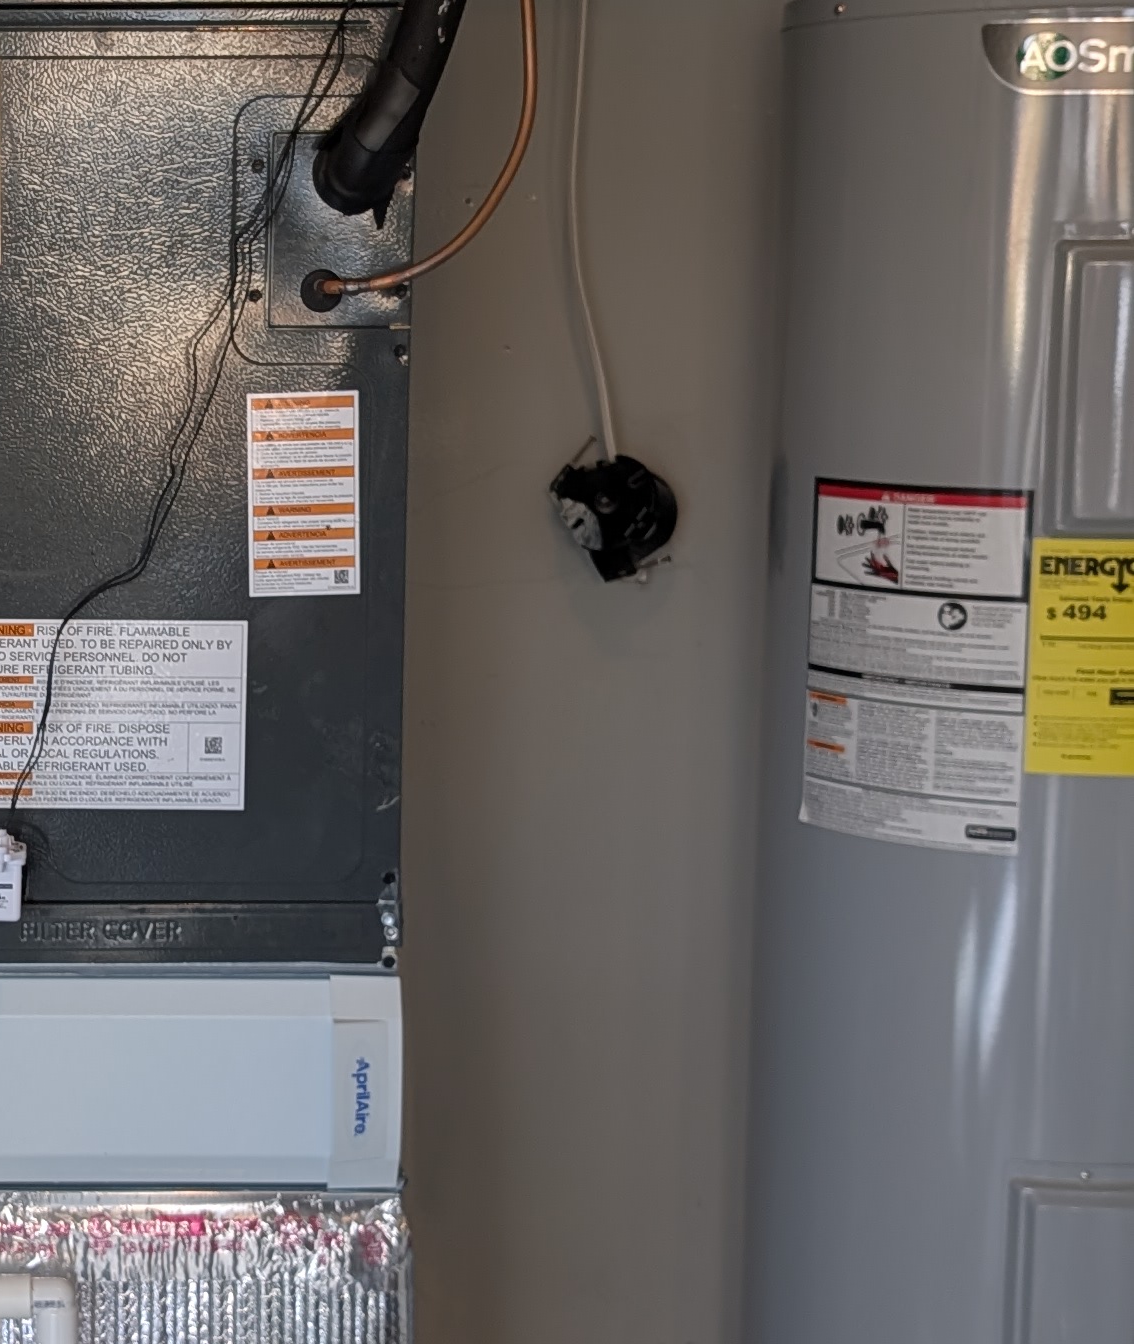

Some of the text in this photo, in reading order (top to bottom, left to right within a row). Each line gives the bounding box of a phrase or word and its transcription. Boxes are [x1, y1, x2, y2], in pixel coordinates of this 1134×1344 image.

[1063, 604, 1107, 621] 494
[68, 626, 84, 636] OF
[86, 626, 116, 636] FIRE.
[119, 627, 190, 637] FLAMMABLE
[81, 639, 96, 650] TO
[100, 639, 116, 650] BE
[119, 640, 180, 650] REPAIRED
[182, 640, 214, 650] ONLY
[217, 640, 233, 650] BY
[64, 652, 139, 662] PERSONNEL.
[142, 652, 159, 663] DO
[162, 653, 187, 663] NOT
[110, 665, 156, 676] TUBING.
[68, 724, 84, 734] OF
[86, 724, 116, 734] FIRE.
[118, 724, 170, 734] DISPOSE
[51, 736, 134, 746] ACCORDANCE
[137, 737, 168, 747] WITH
[11, 749, 29, 758] OR
[73, 749, 159, 759] REGULATIONS.
[114, 762, 149, 772] USED.
[103, 920, 182, 941] COVER
[351, 1057, 370, 1135] AprilAire
